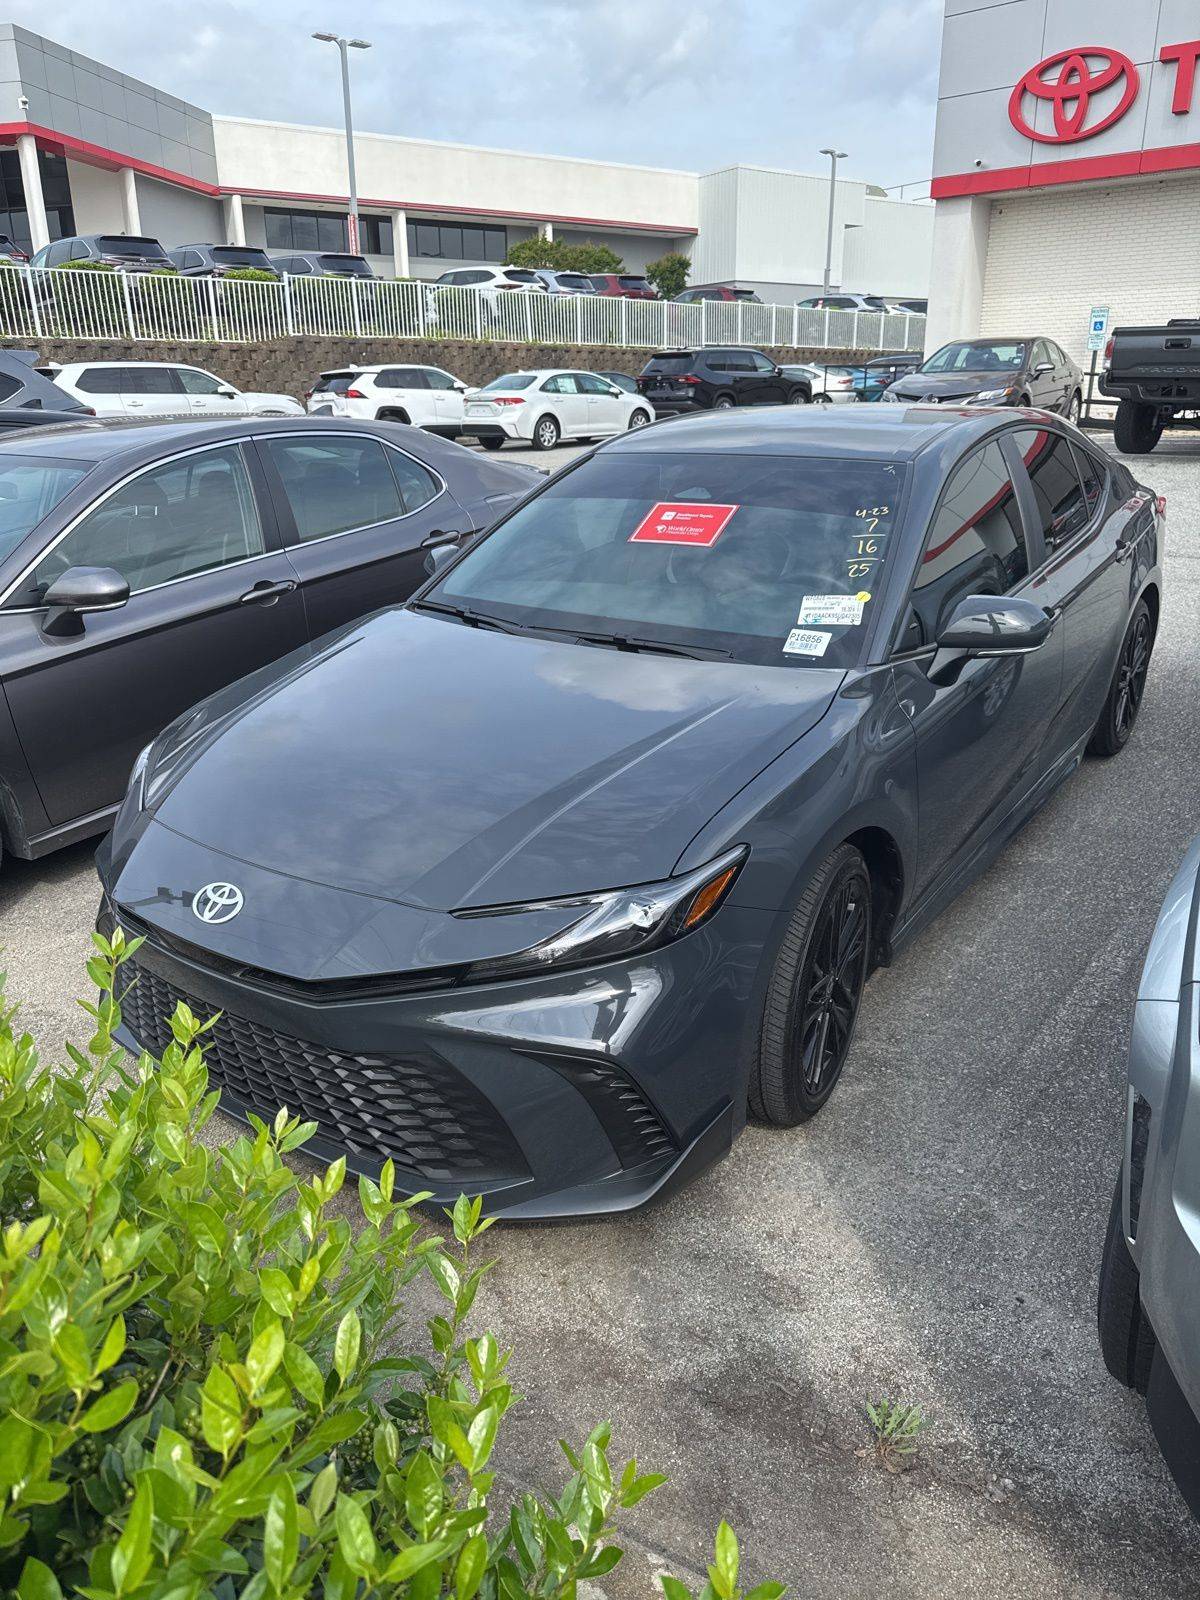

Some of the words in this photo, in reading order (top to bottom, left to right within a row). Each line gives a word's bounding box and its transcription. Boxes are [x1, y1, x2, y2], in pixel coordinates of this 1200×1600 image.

[1159, 40, 1200, 115] T
[855, 506, 889, 518] 4-23
[865, 518, 878, 533] 7
[858, 540, 878, 555] 16
[848, 563, 873, 578] 25
[790, 632, 823, 643] P16856
